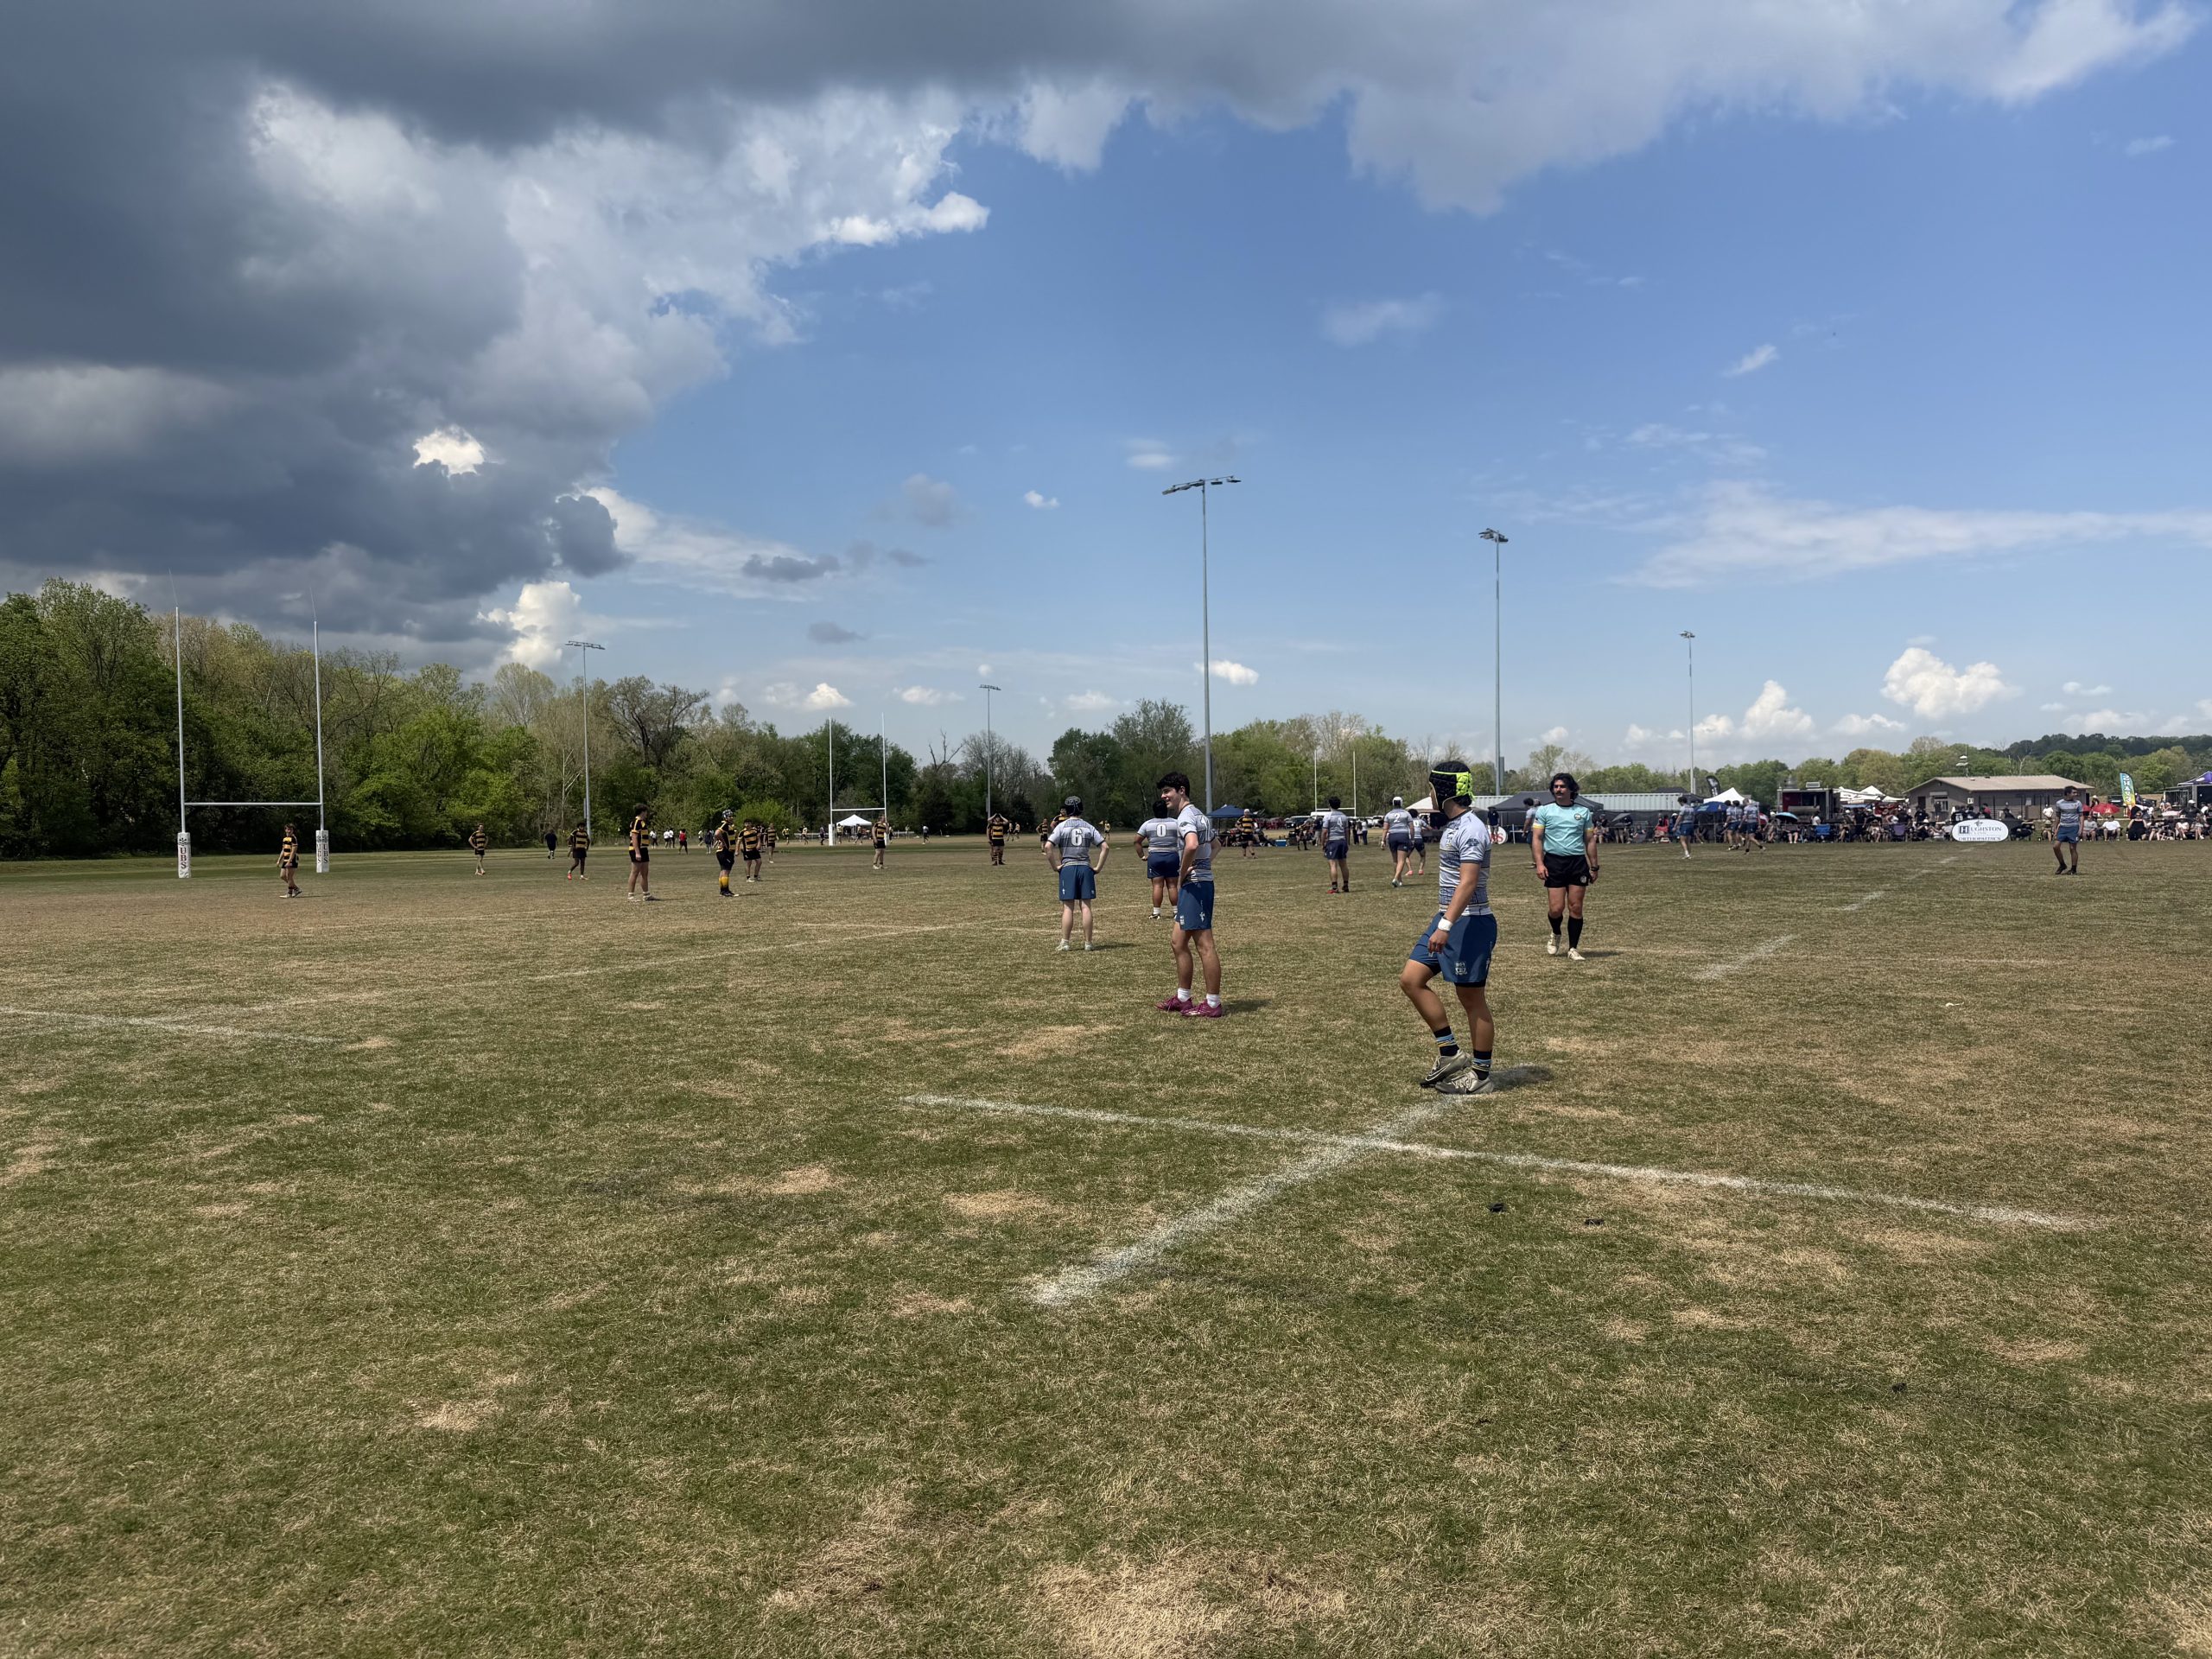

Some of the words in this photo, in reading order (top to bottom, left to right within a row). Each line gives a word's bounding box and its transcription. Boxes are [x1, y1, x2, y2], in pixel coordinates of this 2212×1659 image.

[1337, 817, 1343, 828] 4
[1394, 813, 1401, 823] 2
[1156, 823, 1166, 837] 0
[1071, 828, 1083, 846] 6
